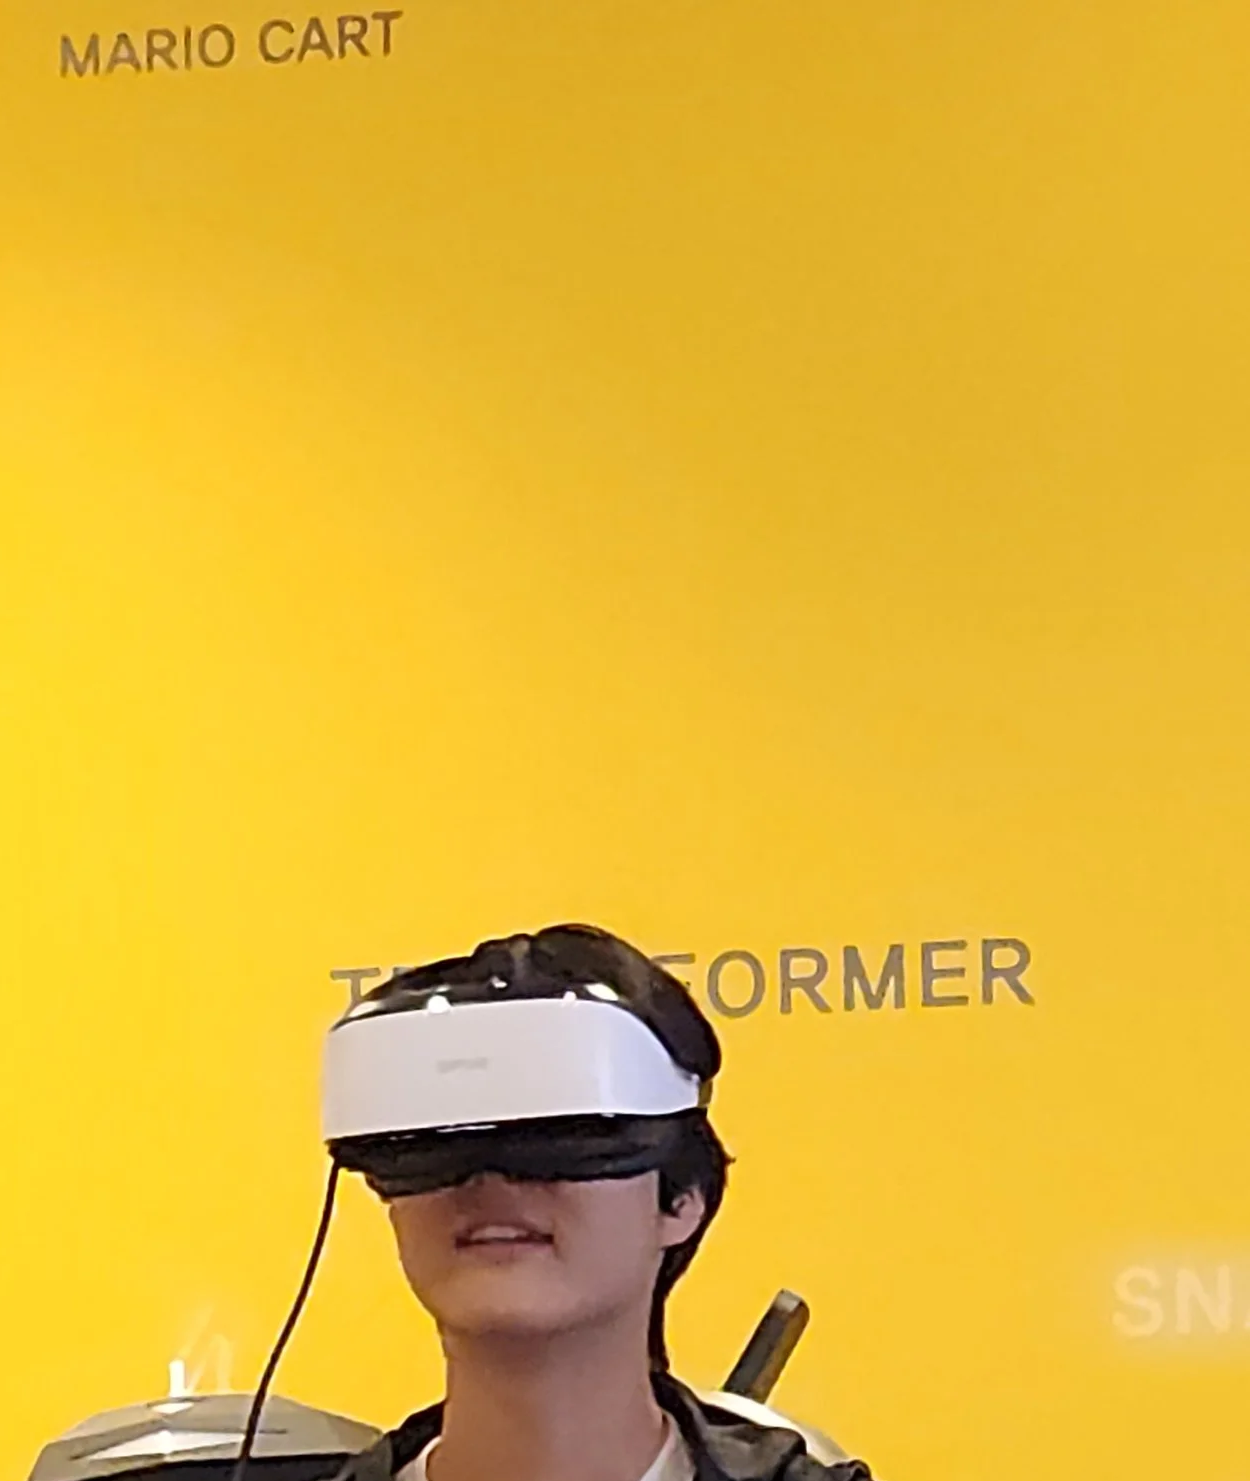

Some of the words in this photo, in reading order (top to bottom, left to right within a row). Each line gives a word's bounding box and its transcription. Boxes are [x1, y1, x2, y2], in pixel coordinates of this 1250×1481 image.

[60, 23, 235, 78] MARIO
[258, 10, 403, 63] CART
[1112, 1264, 1250, 1337] SN
